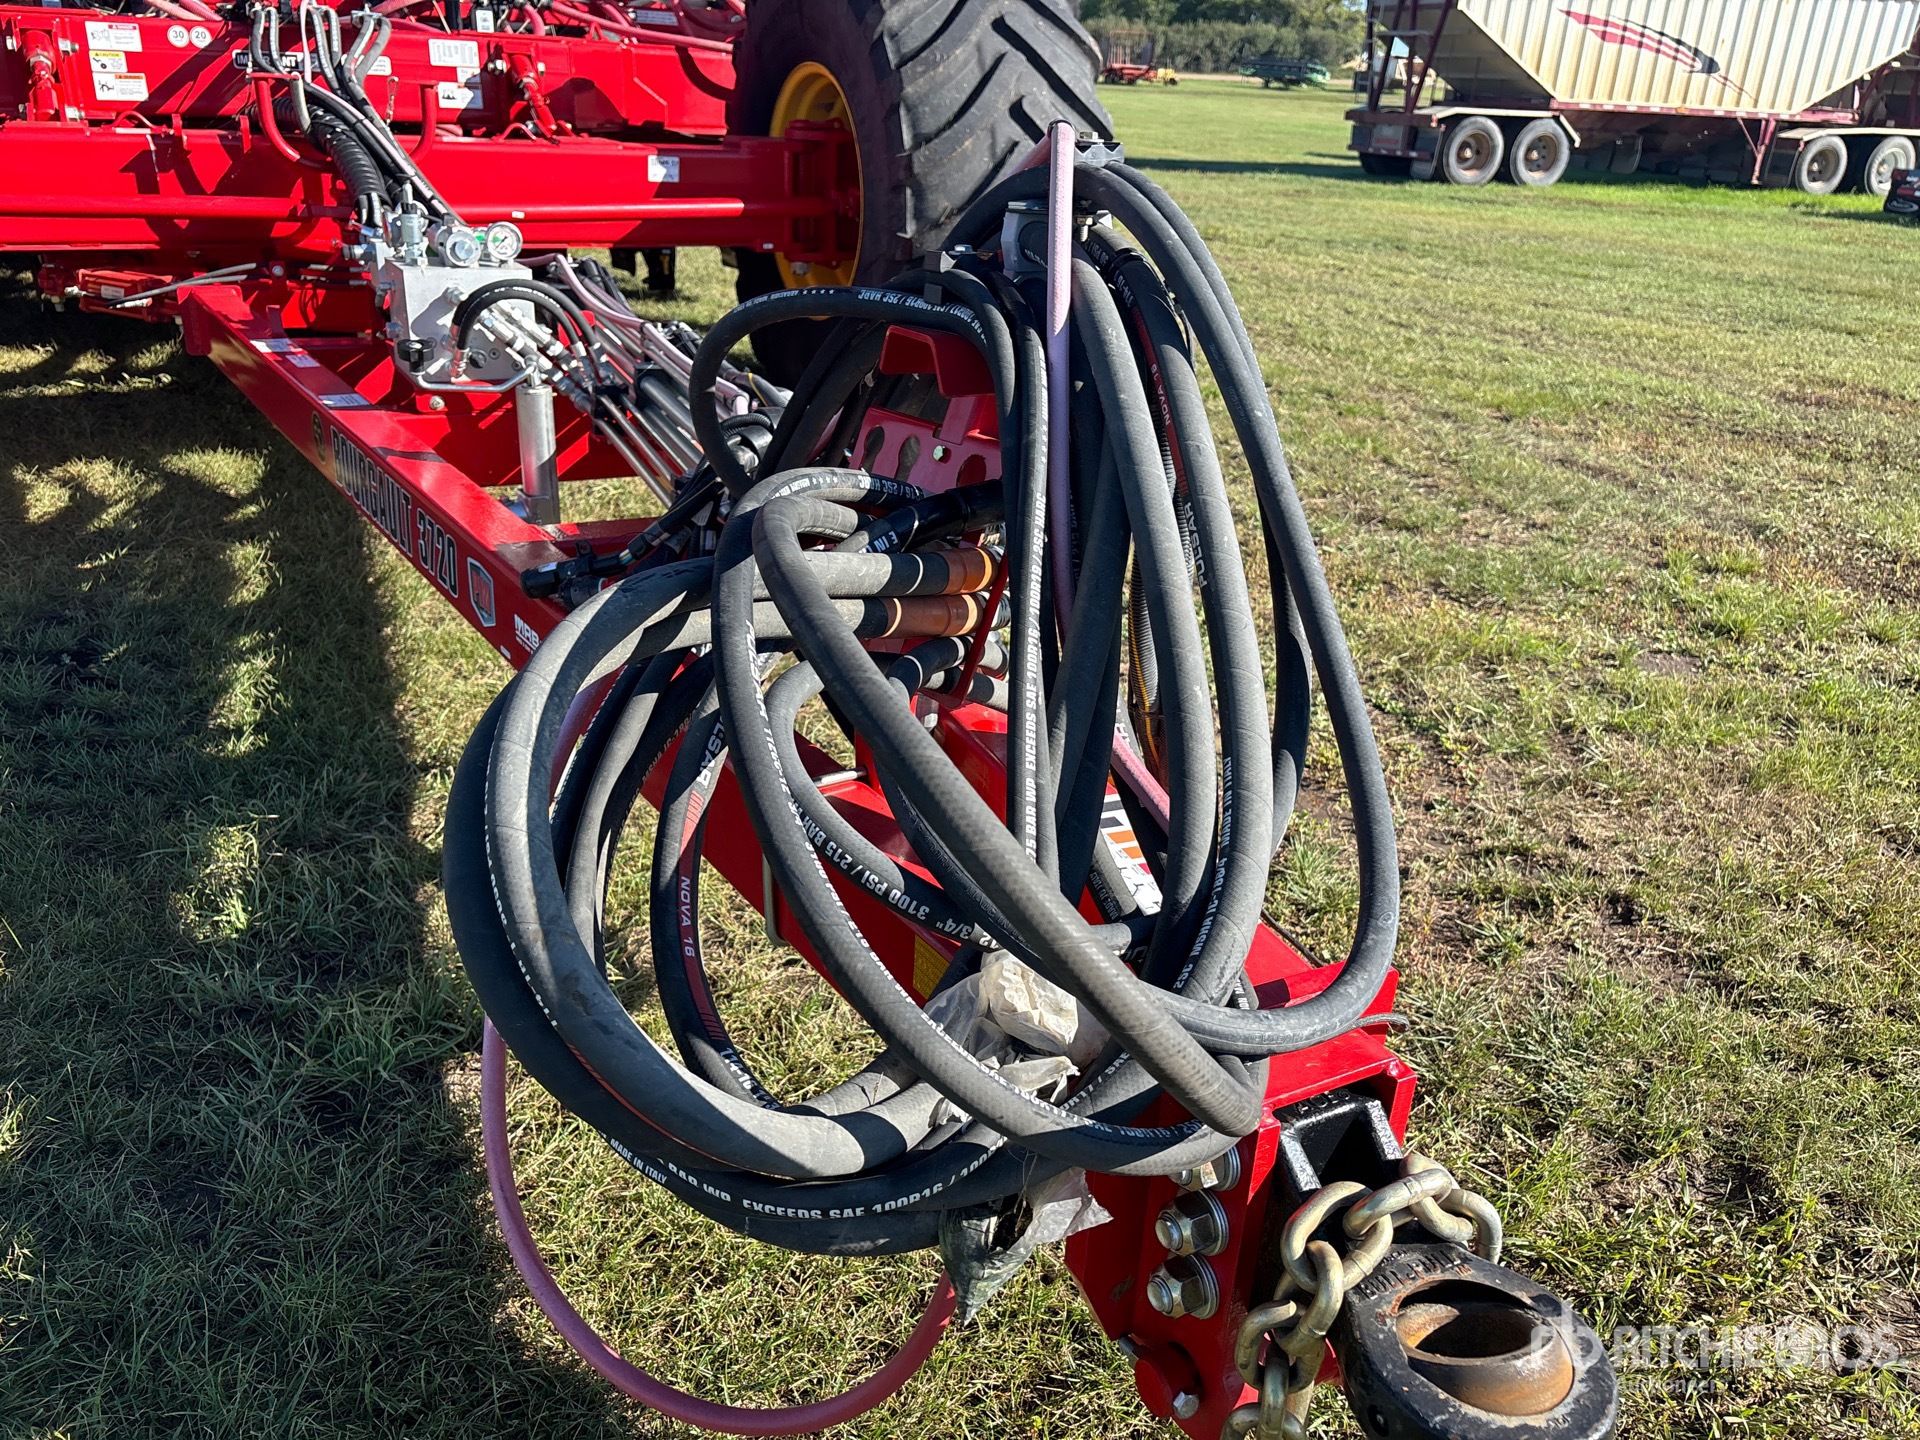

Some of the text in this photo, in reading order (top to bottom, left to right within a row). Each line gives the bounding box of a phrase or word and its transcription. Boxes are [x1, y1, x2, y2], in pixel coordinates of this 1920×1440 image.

[172, 30, 185, 39] 30
[194, 30, 207, 39] 20
[1157, 384, 1171, 426] NOVA
[330, 424, 413, 558] BOURGAULT
[416, 507, 459, 599] 3720
[1035, 493, 1047, 527] HARC
[1032, 529, 1045, 552] 2SC
[1184, 501, 1208, 588] PULSAR
[1029, 571, 1043, 615] 100R19
[1026, 625, 1040, 680] 100R16
[1026, 681, 1038, 711] SAE
[696, 716, 725, 789] LSAR
[1025, 717, 1037, 772] EXCEEDS
[1026, 777, 1037, 802] WP
[1223, 756, 1233, 790] ITALY
[1223, 790, 1233, 808] IN
[1026, 806, 1037, 837] BAR
[1220, 808, 1232, 847] MADE
[824, 841, 853, 870] 215
[860, 869, 889, 896] PSI
[680, 875, 695, 958] NOVA 16
[888, 888, 930, 921] 3100
[1190, 914, 1214, 957] MSHA
[1172, 962, 1194, 990] 2SC
[1104, 1052, 1131, 1075] SAE
[610, 1138, 668, 1185] MADE IN ITALY
